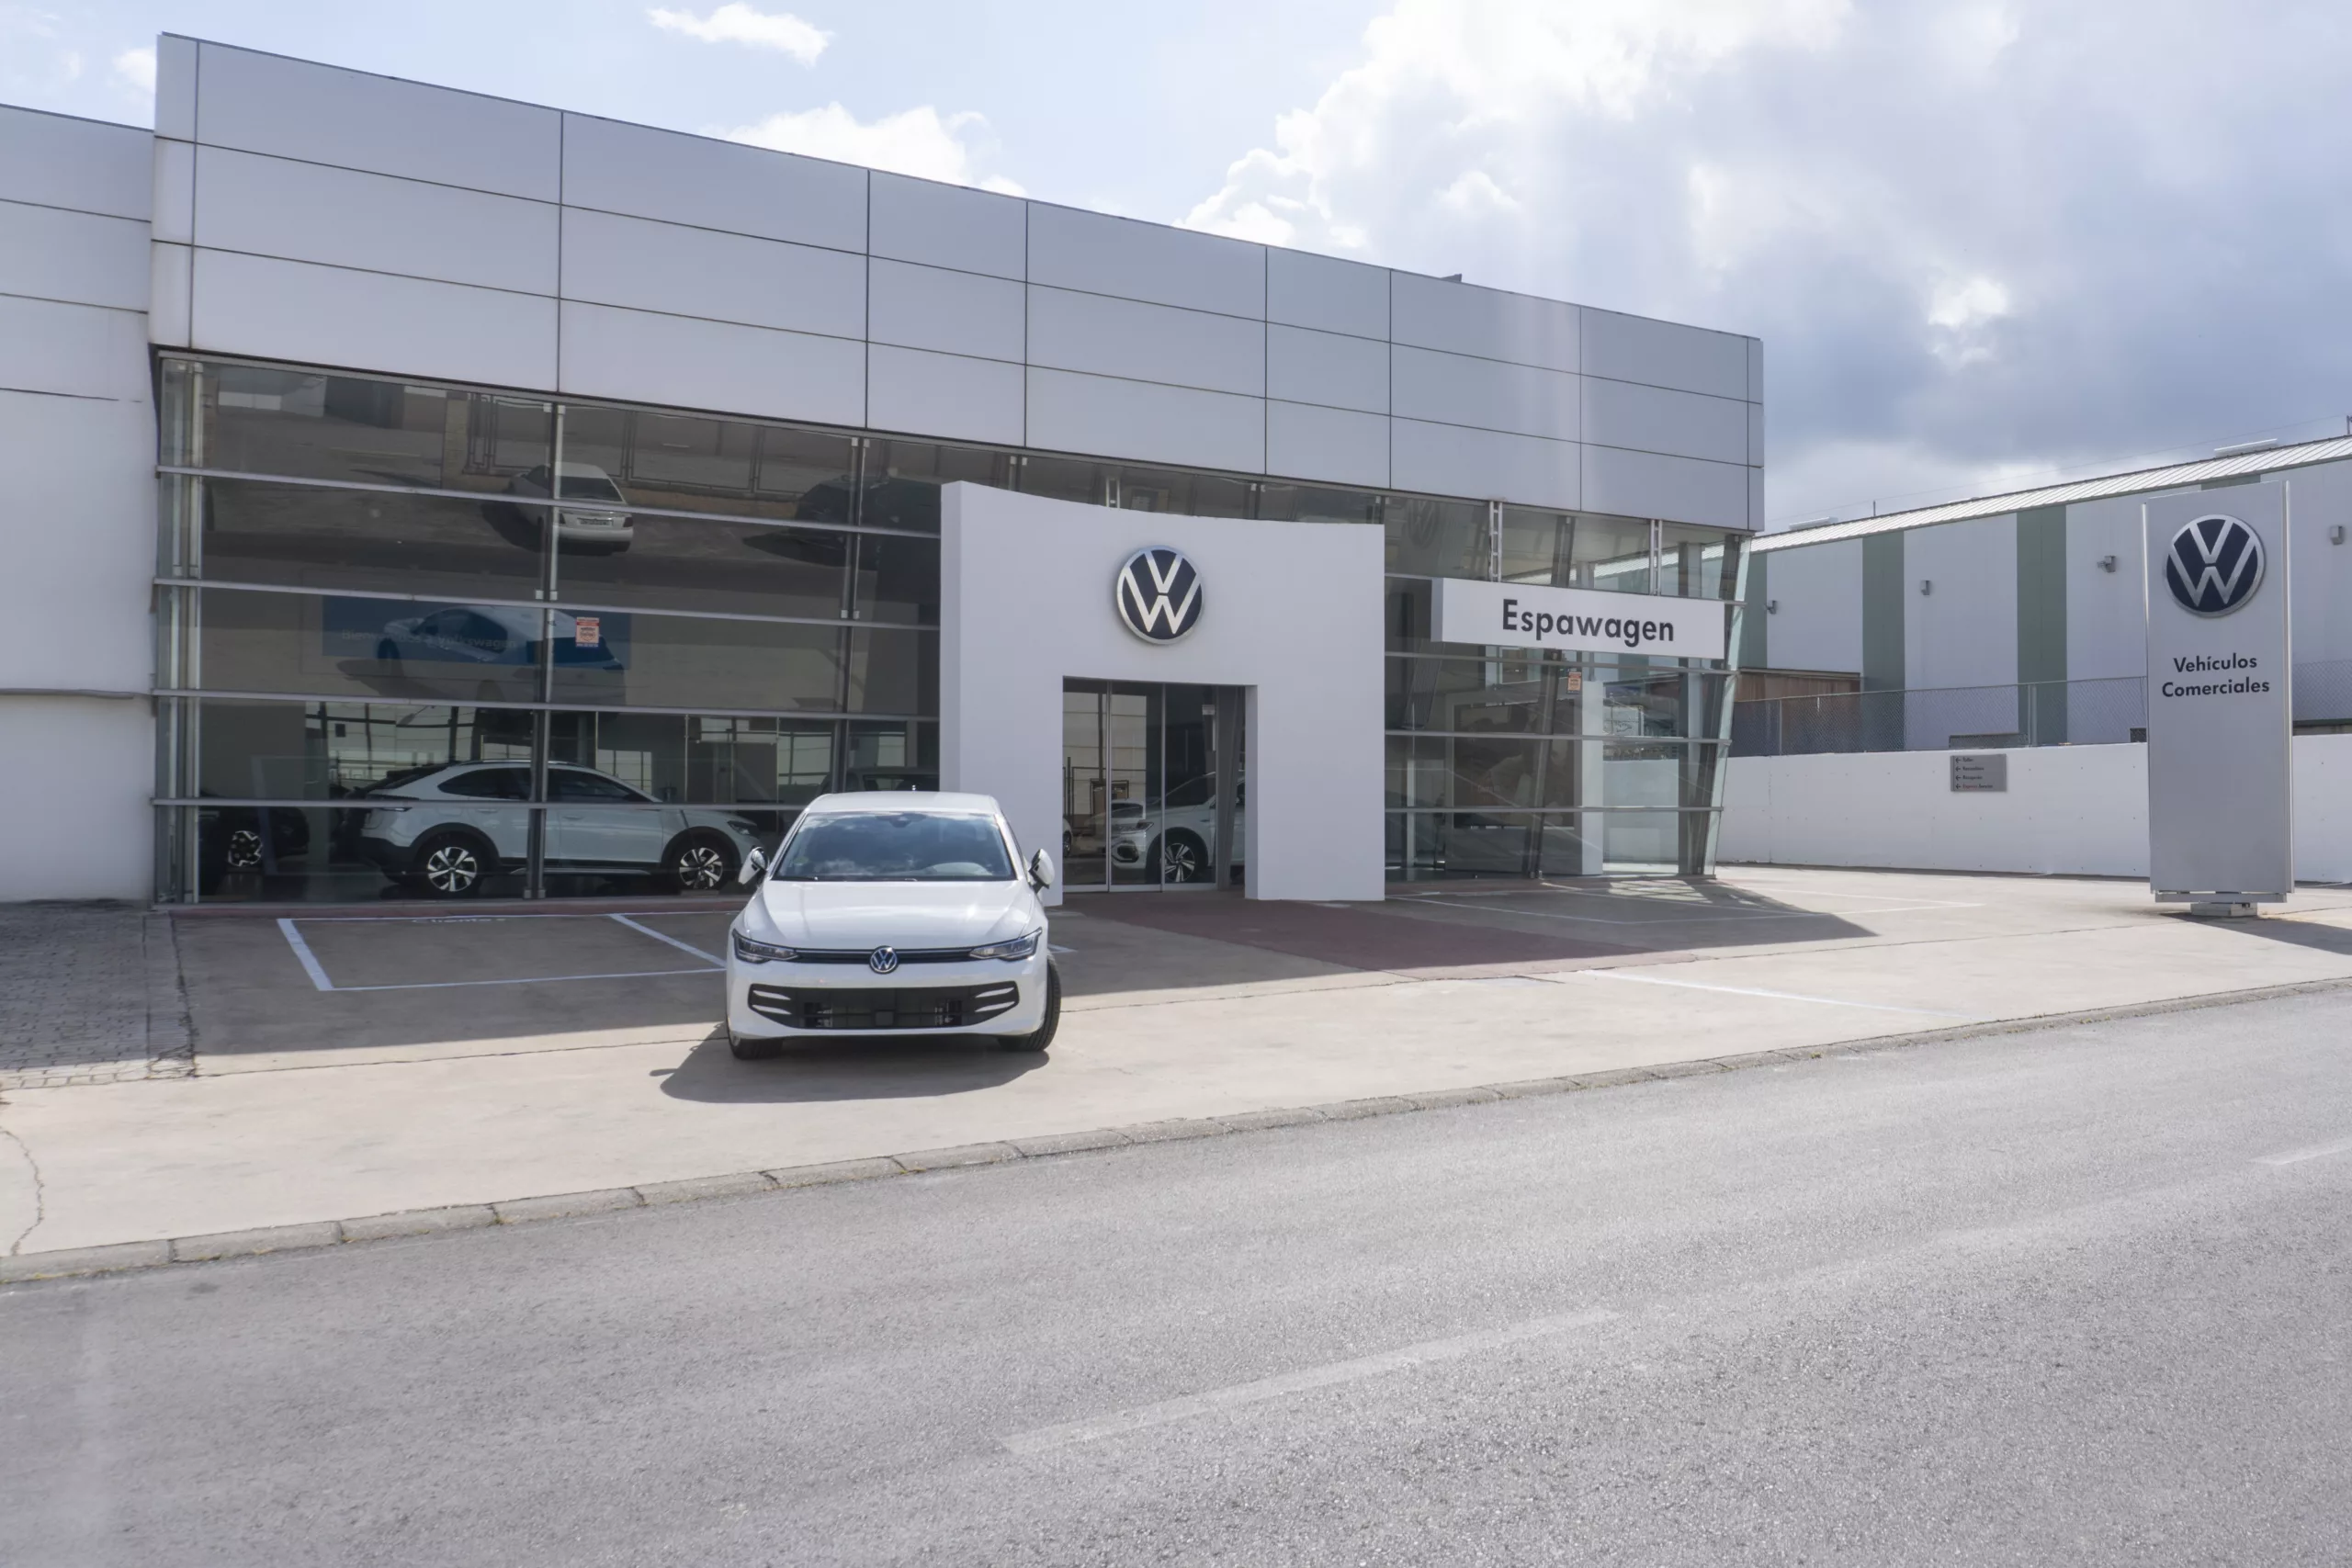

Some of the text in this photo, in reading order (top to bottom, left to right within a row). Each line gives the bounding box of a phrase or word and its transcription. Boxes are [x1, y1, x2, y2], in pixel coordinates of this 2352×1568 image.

[2166, 516, 2263, 614] VW
[1119, 548, 1203, 640] VW
[1502, 598, 1675, 648] Espawagen
[2173, 652, 2257, 673] Vehículos
[2161, 676, 2270, 698] Comerciales
[870, 947, 899, 973] VW
